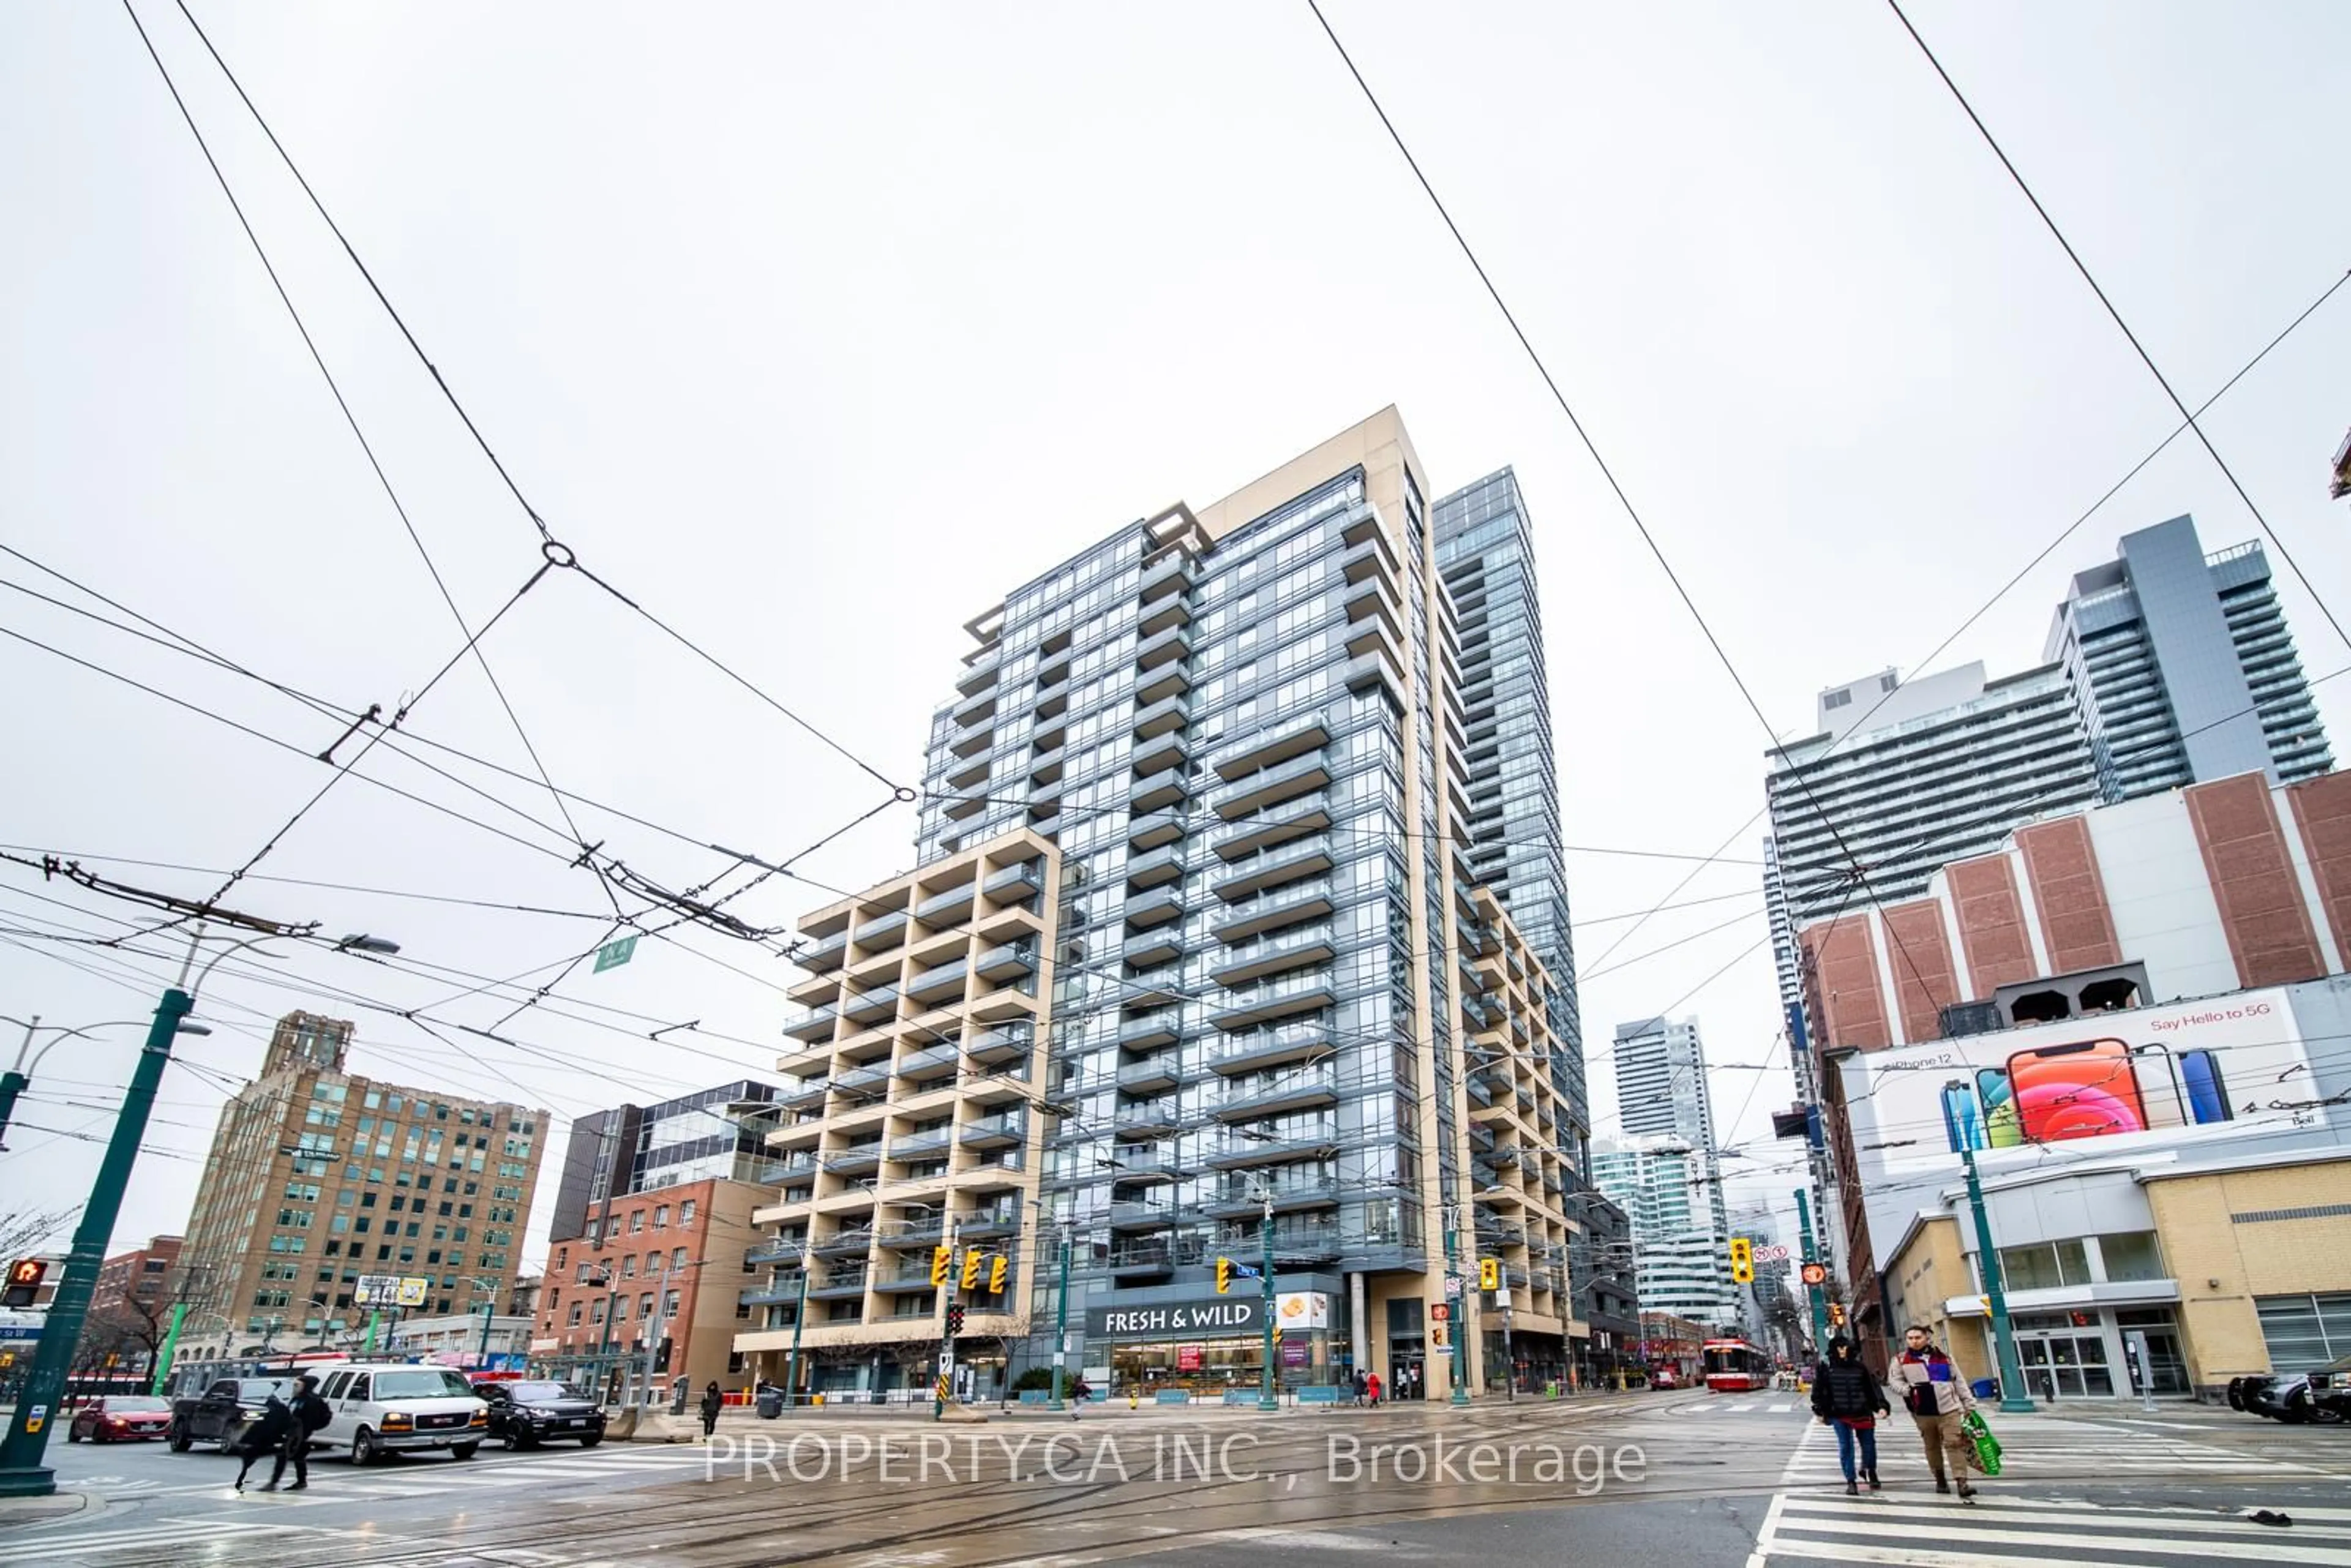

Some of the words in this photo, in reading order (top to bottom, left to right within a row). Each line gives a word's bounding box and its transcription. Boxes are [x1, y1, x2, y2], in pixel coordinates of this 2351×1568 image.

[2151, 1019, 2180, 1030] Say
[2182, 1011, 2224, 1026] Hello
[2226, 1010, 2243, 1019] to
[2245, 1003, 2271, 1016] 5G
[1938, 1053, 1951, 1064] 12
[2292, 1115, 2314, 1125] Bell
[1105, 1310, 1166, 1332] FRESH
[1172, 1308, 1187, 1328] &
[1191, 1304, 1251, 1327] WILD
